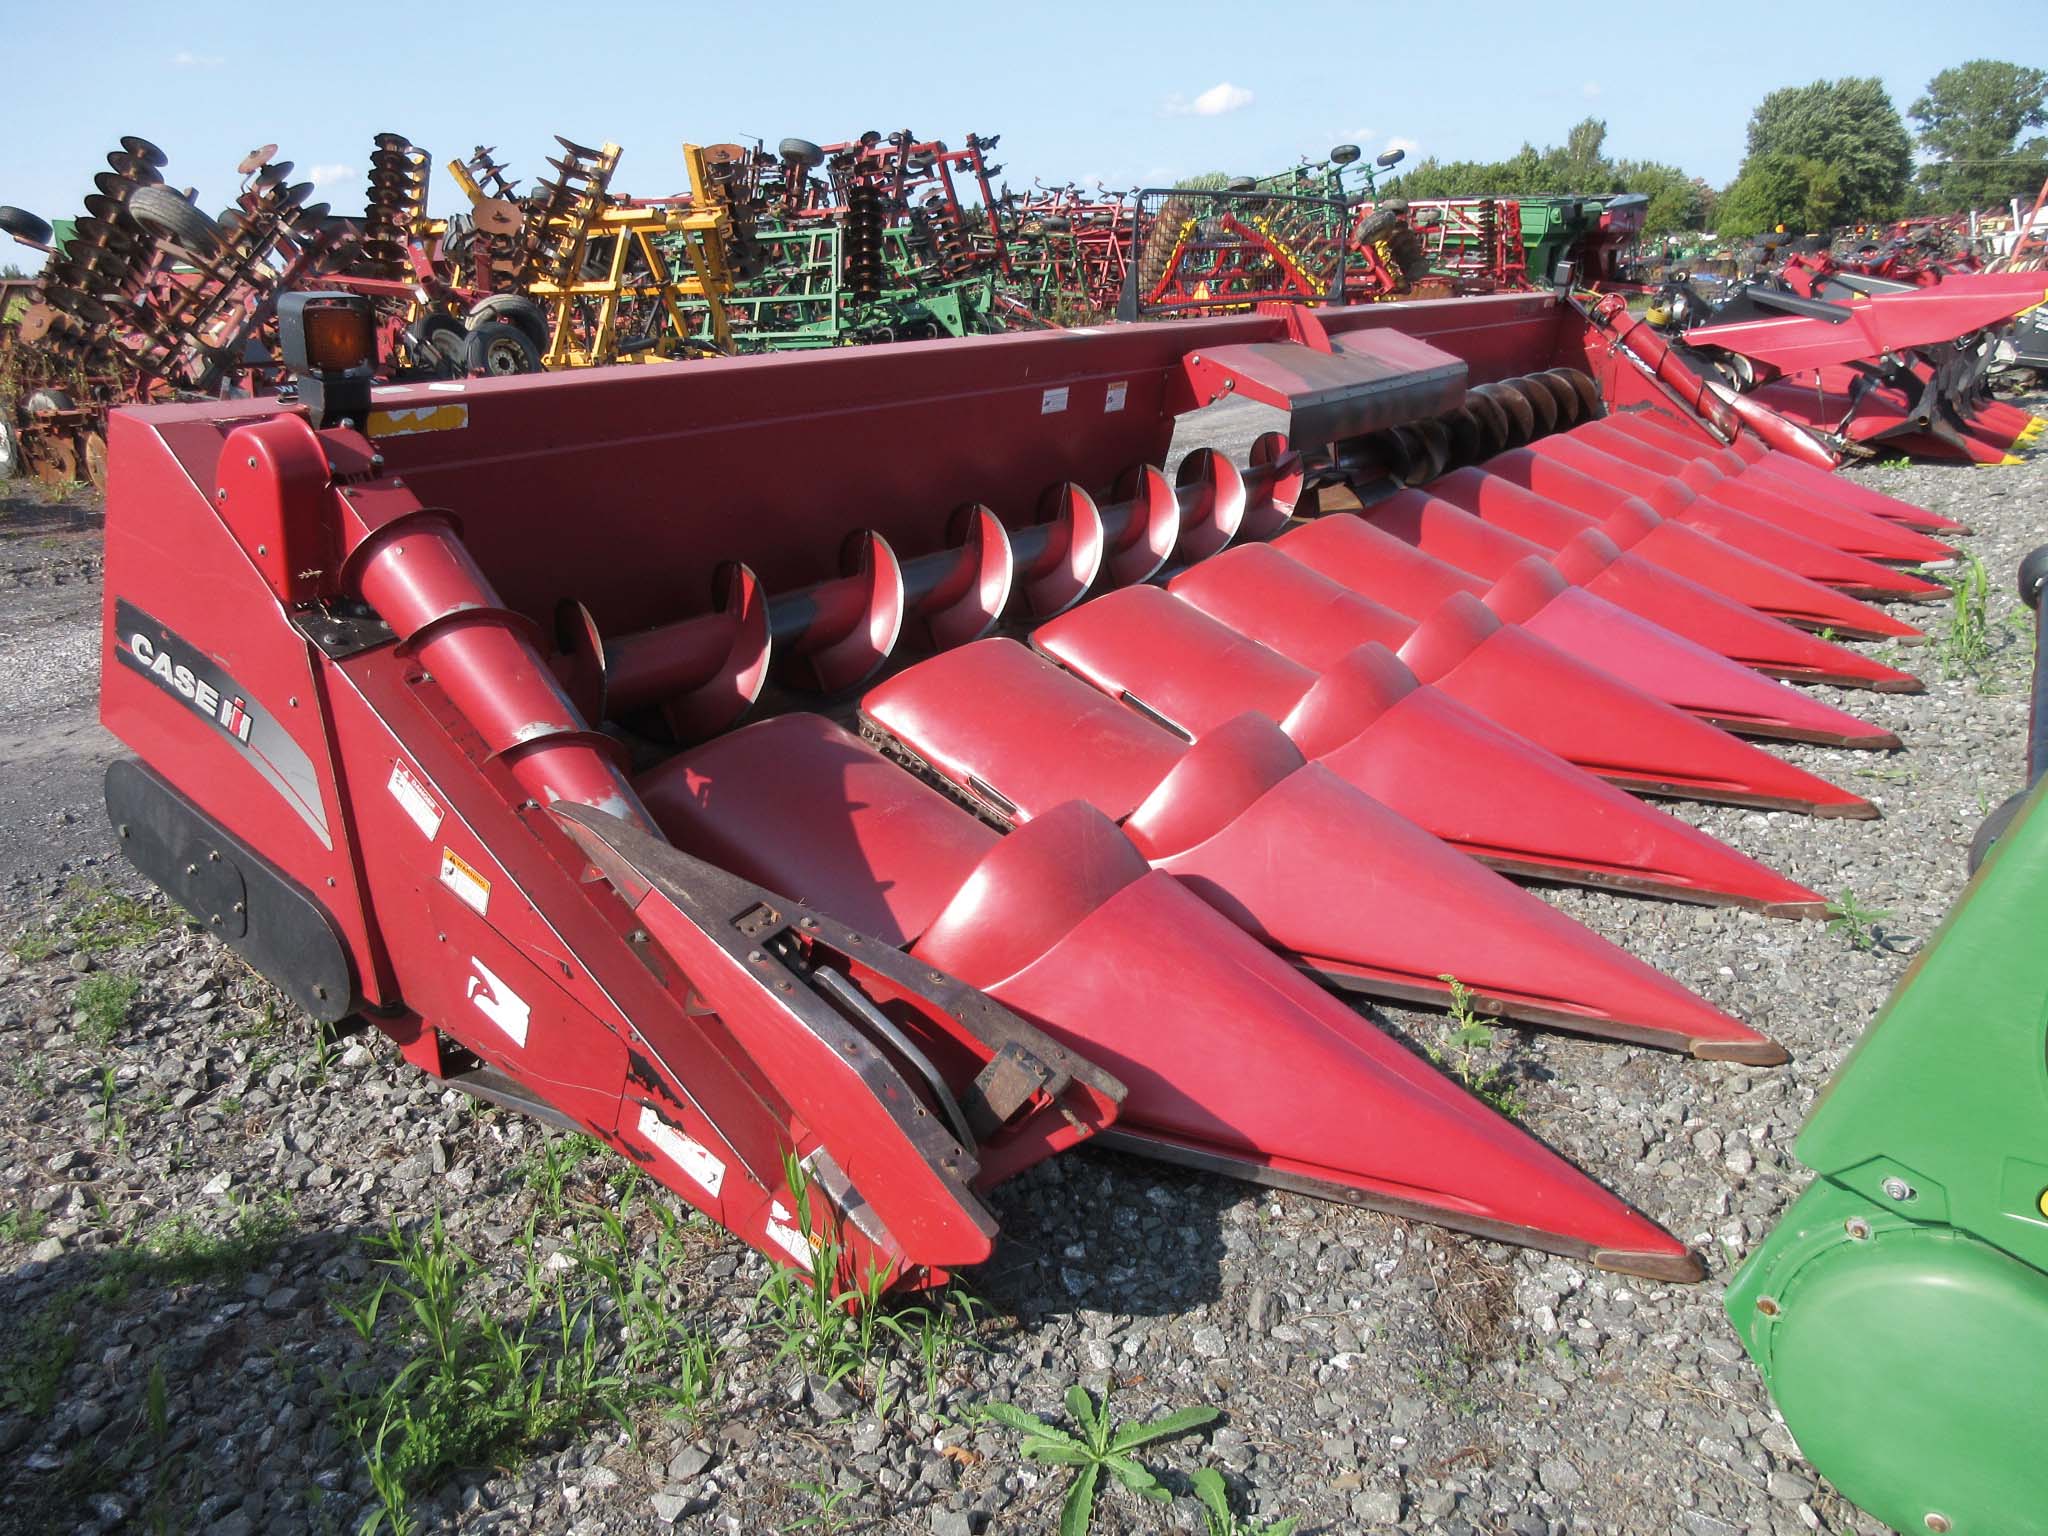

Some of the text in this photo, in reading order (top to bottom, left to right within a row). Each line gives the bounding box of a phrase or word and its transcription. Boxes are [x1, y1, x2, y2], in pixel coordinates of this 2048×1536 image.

[131, 633, 220, 718] CASE
[411, 779, 436, 810] DANGER
[456, 860, 487, 889] WARNING
